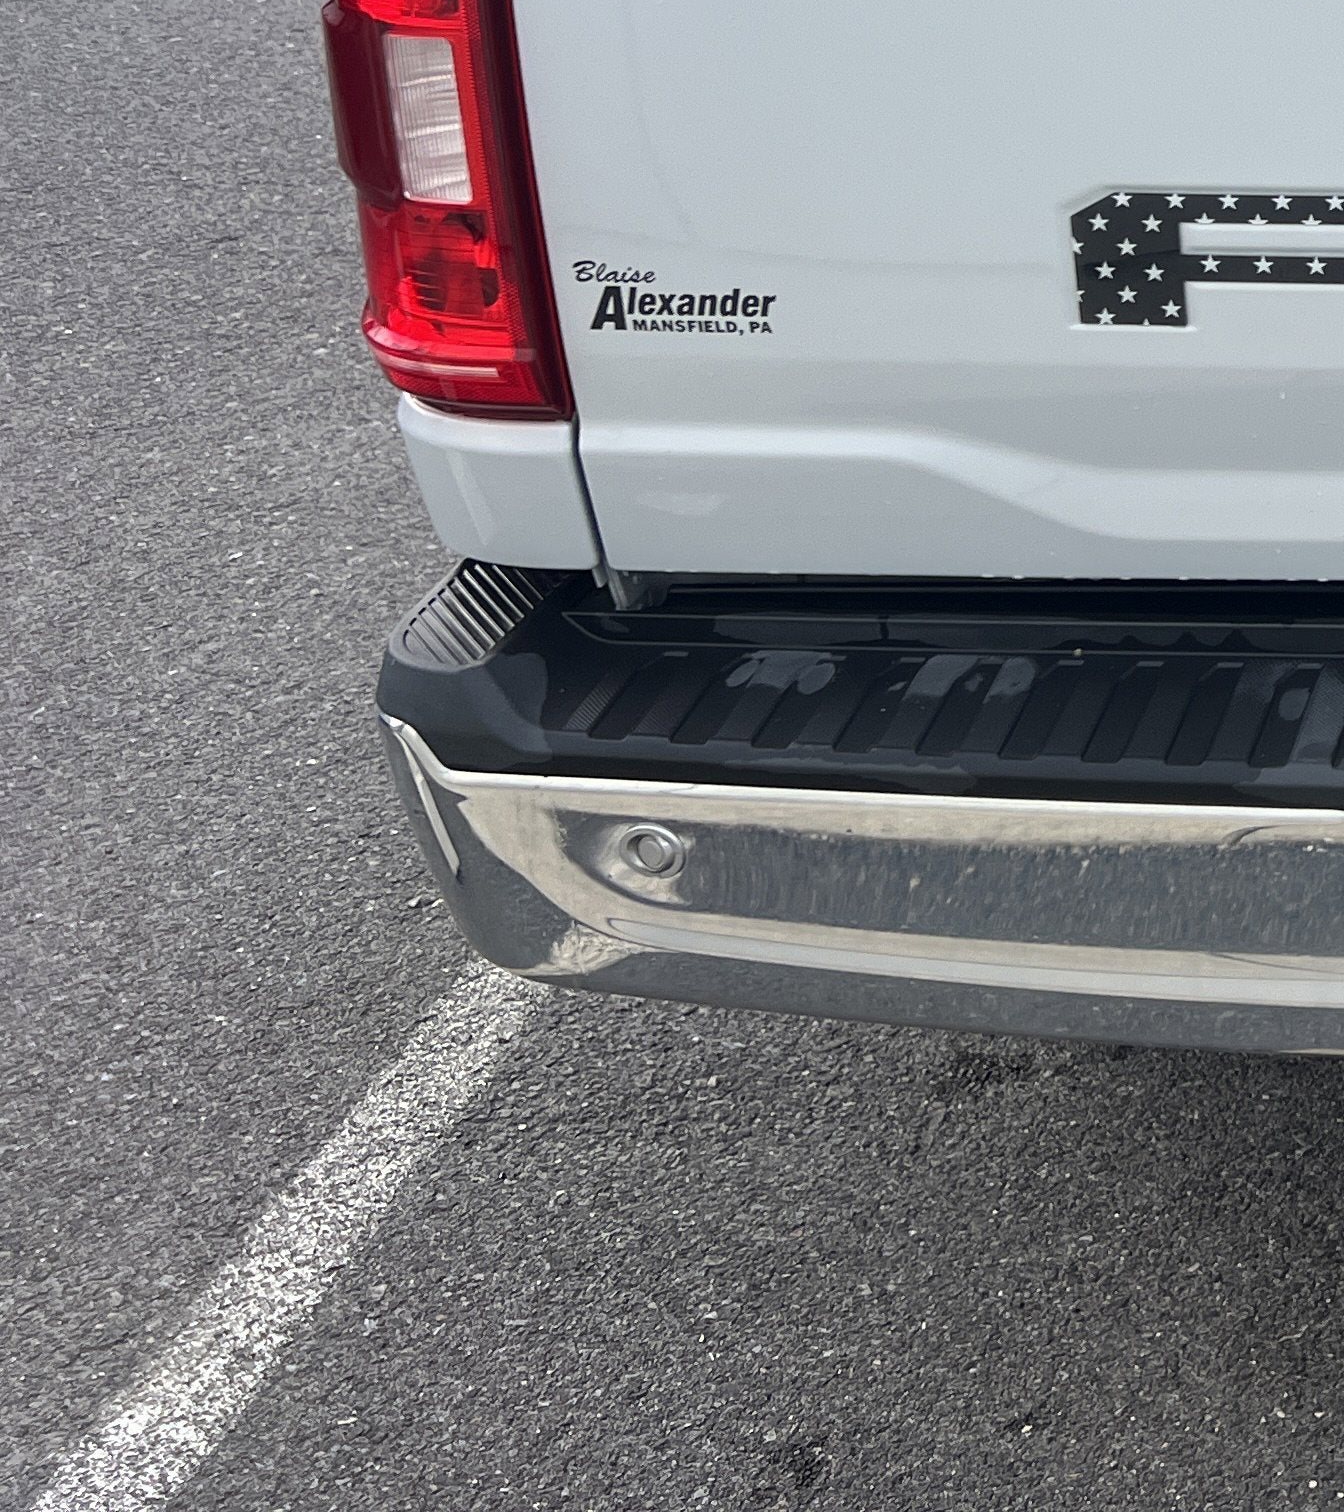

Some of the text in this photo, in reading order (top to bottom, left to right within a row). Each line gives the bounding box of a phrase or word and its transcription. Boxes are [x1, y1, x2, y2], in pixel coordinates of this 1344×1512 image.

[572, 259, 657, 283] Blaise
[589, 285, 777, 331] Alexander
[632, 319, 773, 336] MANSFIELD, PA
